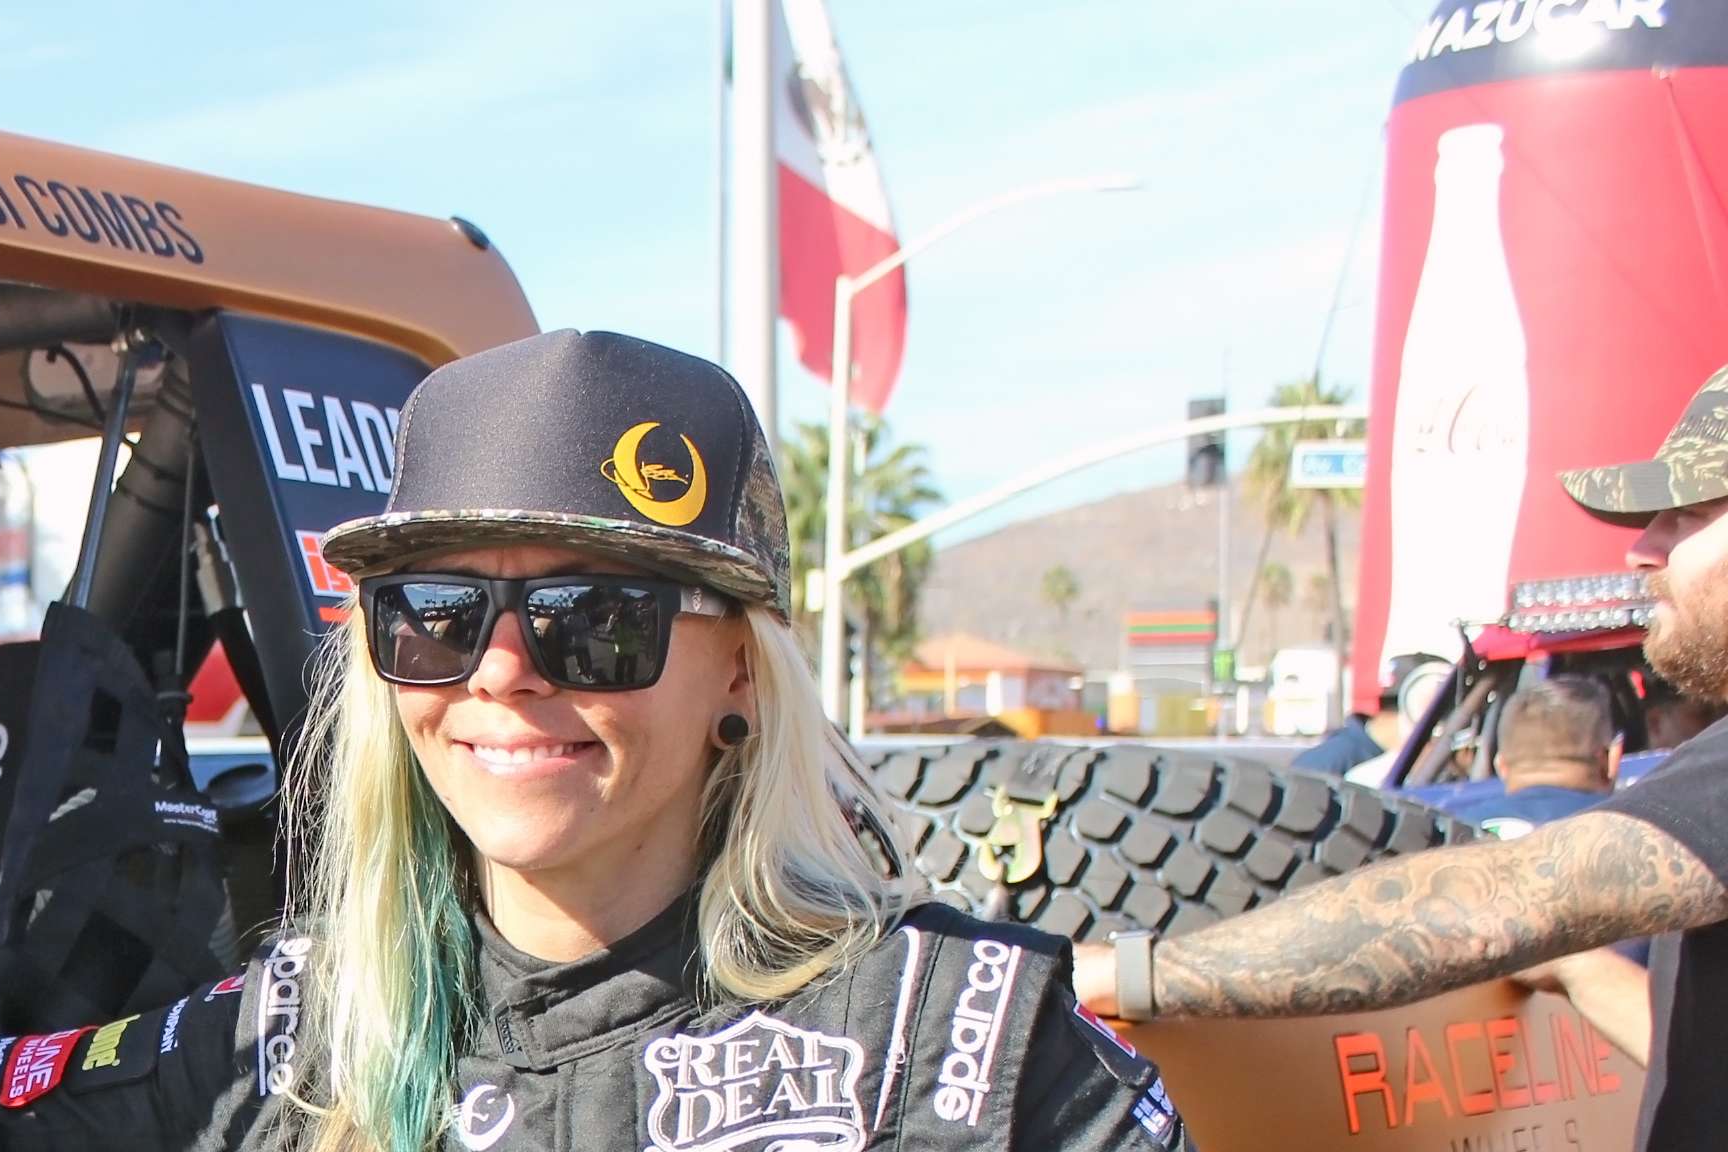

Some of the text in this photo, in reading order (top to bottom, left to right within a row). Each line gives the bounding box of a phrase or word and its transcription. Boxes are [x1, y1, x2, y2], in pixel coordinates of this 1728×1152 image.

[13, 175, 204, 265] COMBS
[251, 384, 400, 494] LEAD
[24, 1029, 80, 1094] LINE
[258, 937, 312, 1096] sparco
[670, 1033, 837, 1090] REAL
[933, 939, 1021, 1127] sparco
[672, 1071, 854, 1146] DEAL
[1334, 1012, 1622, 1135] RACELINE
